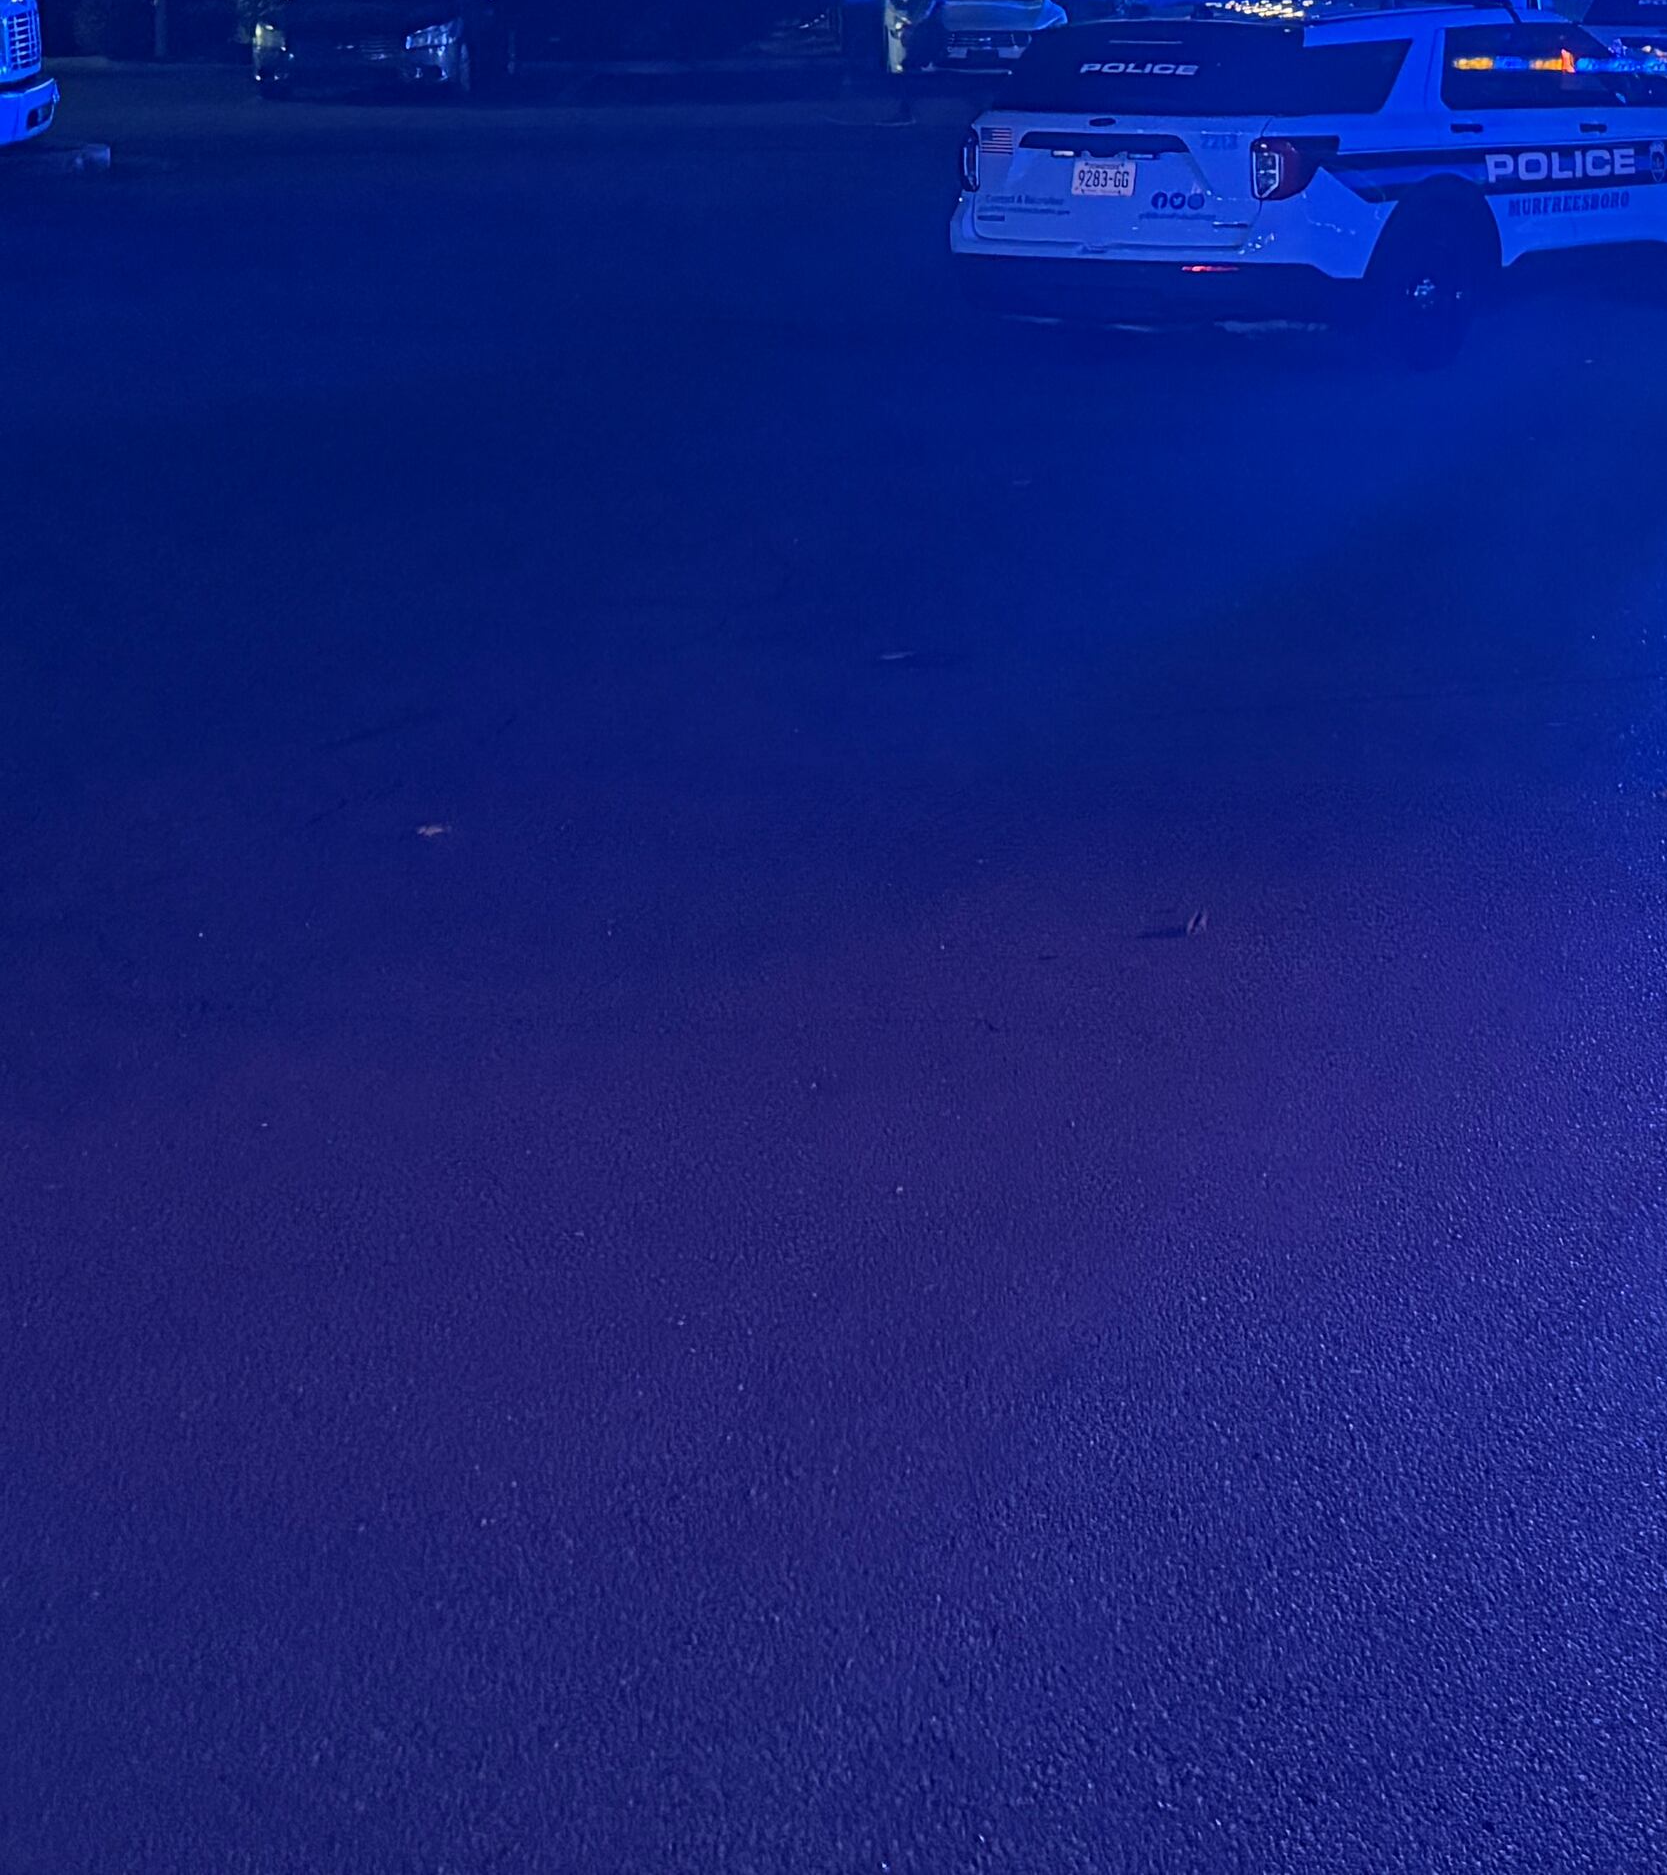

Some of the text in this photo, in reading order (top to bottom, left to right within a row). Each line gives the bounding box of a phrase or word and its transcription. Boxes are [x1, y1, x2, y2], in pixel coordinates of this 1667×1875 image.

[1080, 63, 1199, 75] POLICE
[1485, 148, 1636, 183] POLICE
[1078, 169, 1130, 189] 9283-GG
[1508, 191, 1630, 217] MURFREESBORO
